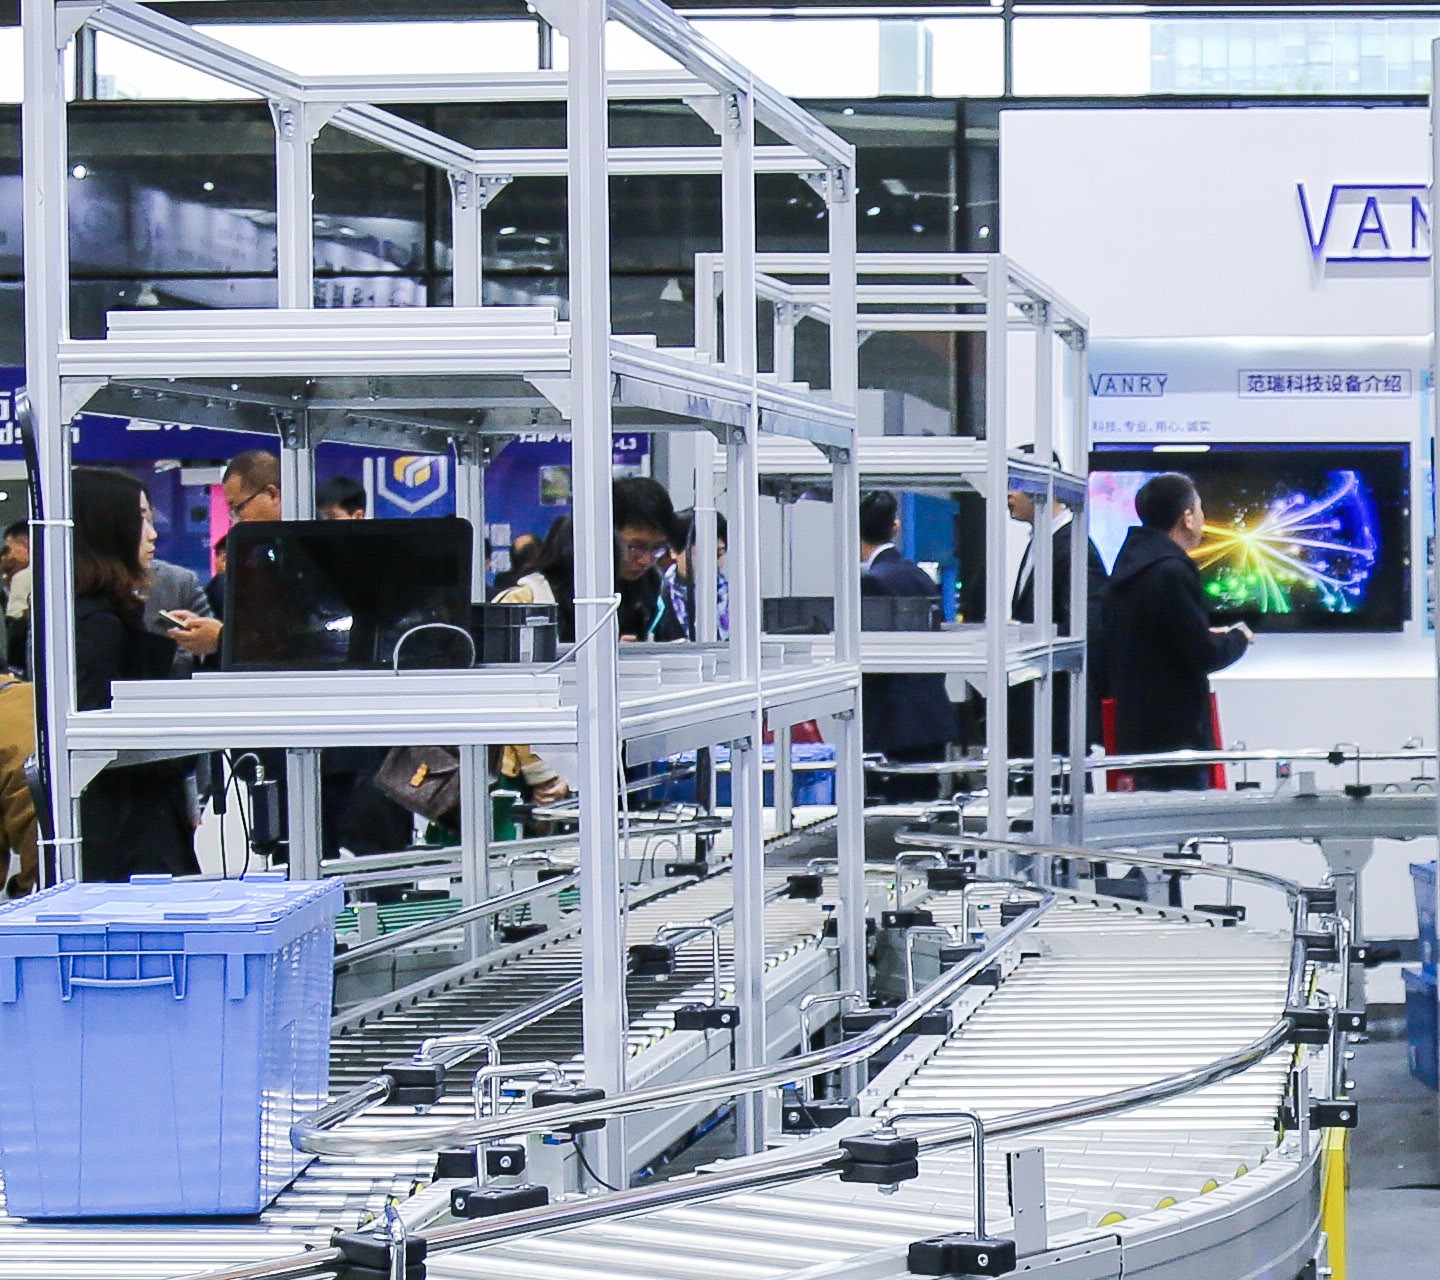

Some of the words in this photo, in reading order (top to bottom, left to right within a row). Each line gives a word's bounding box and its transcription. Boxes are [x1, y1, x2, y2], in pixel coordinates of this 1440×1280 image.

[1090, 373, 1168, 397] VANRY
[1247, 374, 1403, 393] 范瑞科技设备介绍
